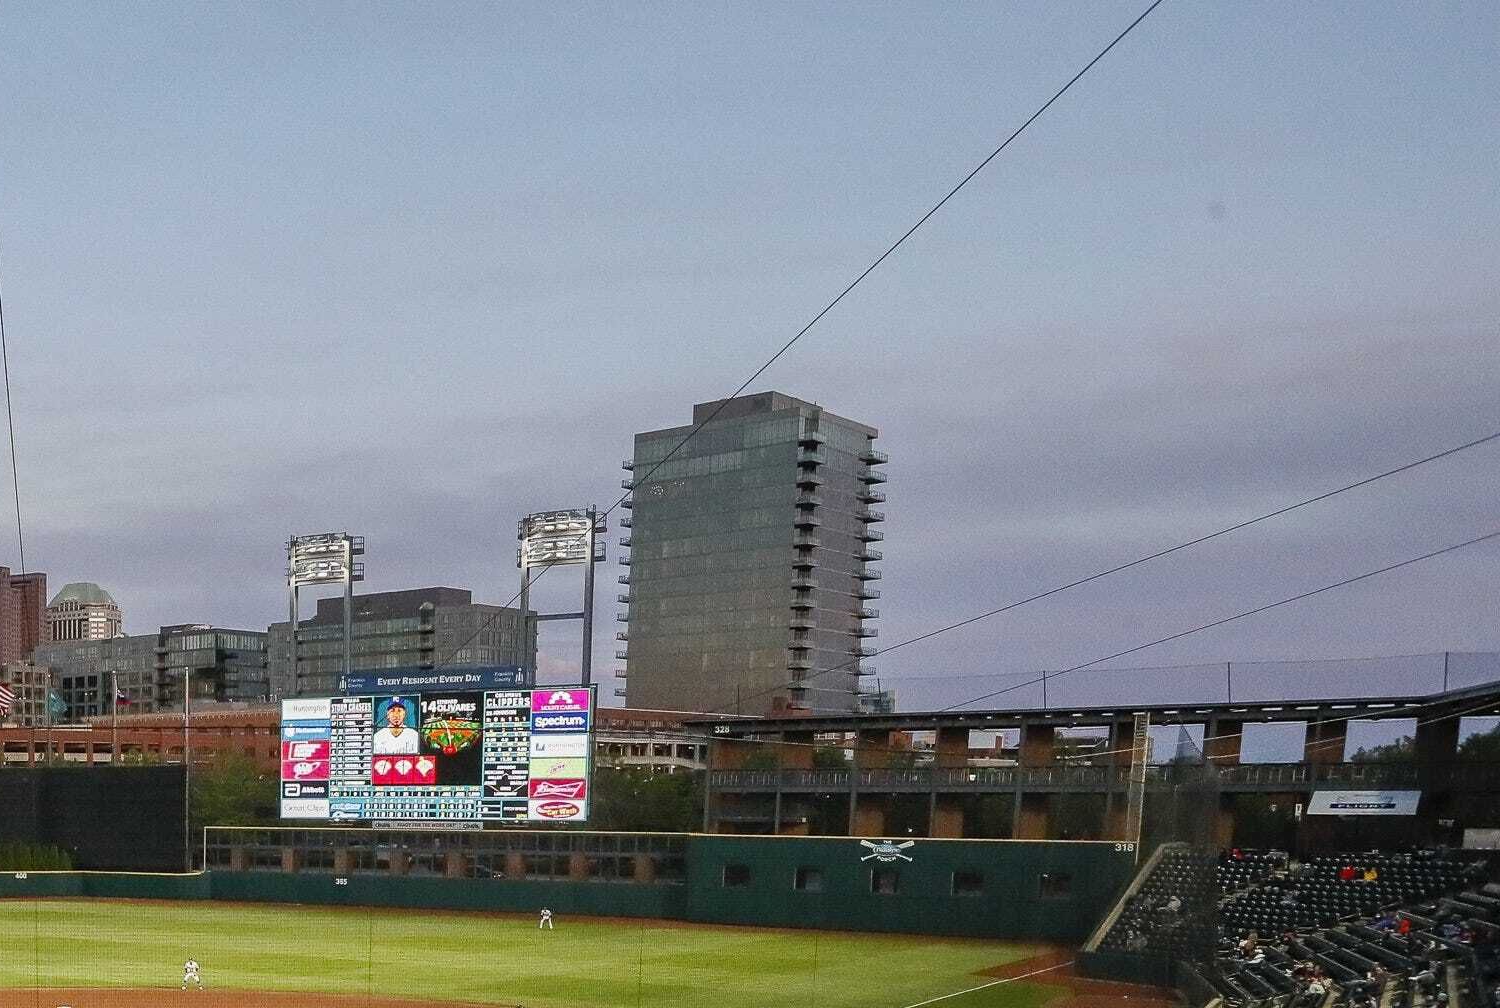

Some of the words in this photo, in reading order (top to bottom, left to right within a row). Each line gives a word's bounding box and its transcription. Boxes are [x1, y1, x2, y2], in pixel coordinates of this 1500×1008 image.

[377, 677, 401, 686] EVERY
[402, 676, 438, 685] RESIDENT
[439, 675, 464, 683] EVERY
[465, 674, 482, 682] DAY
[421, 701, 437, 713] 14
[437, 703, 476, 713] OLIVARES
[486, 697, 531, 708] CLIPPERS
[534, 716, 576, 729] Spectrum
[1115, 843, 1134, 851] 318
